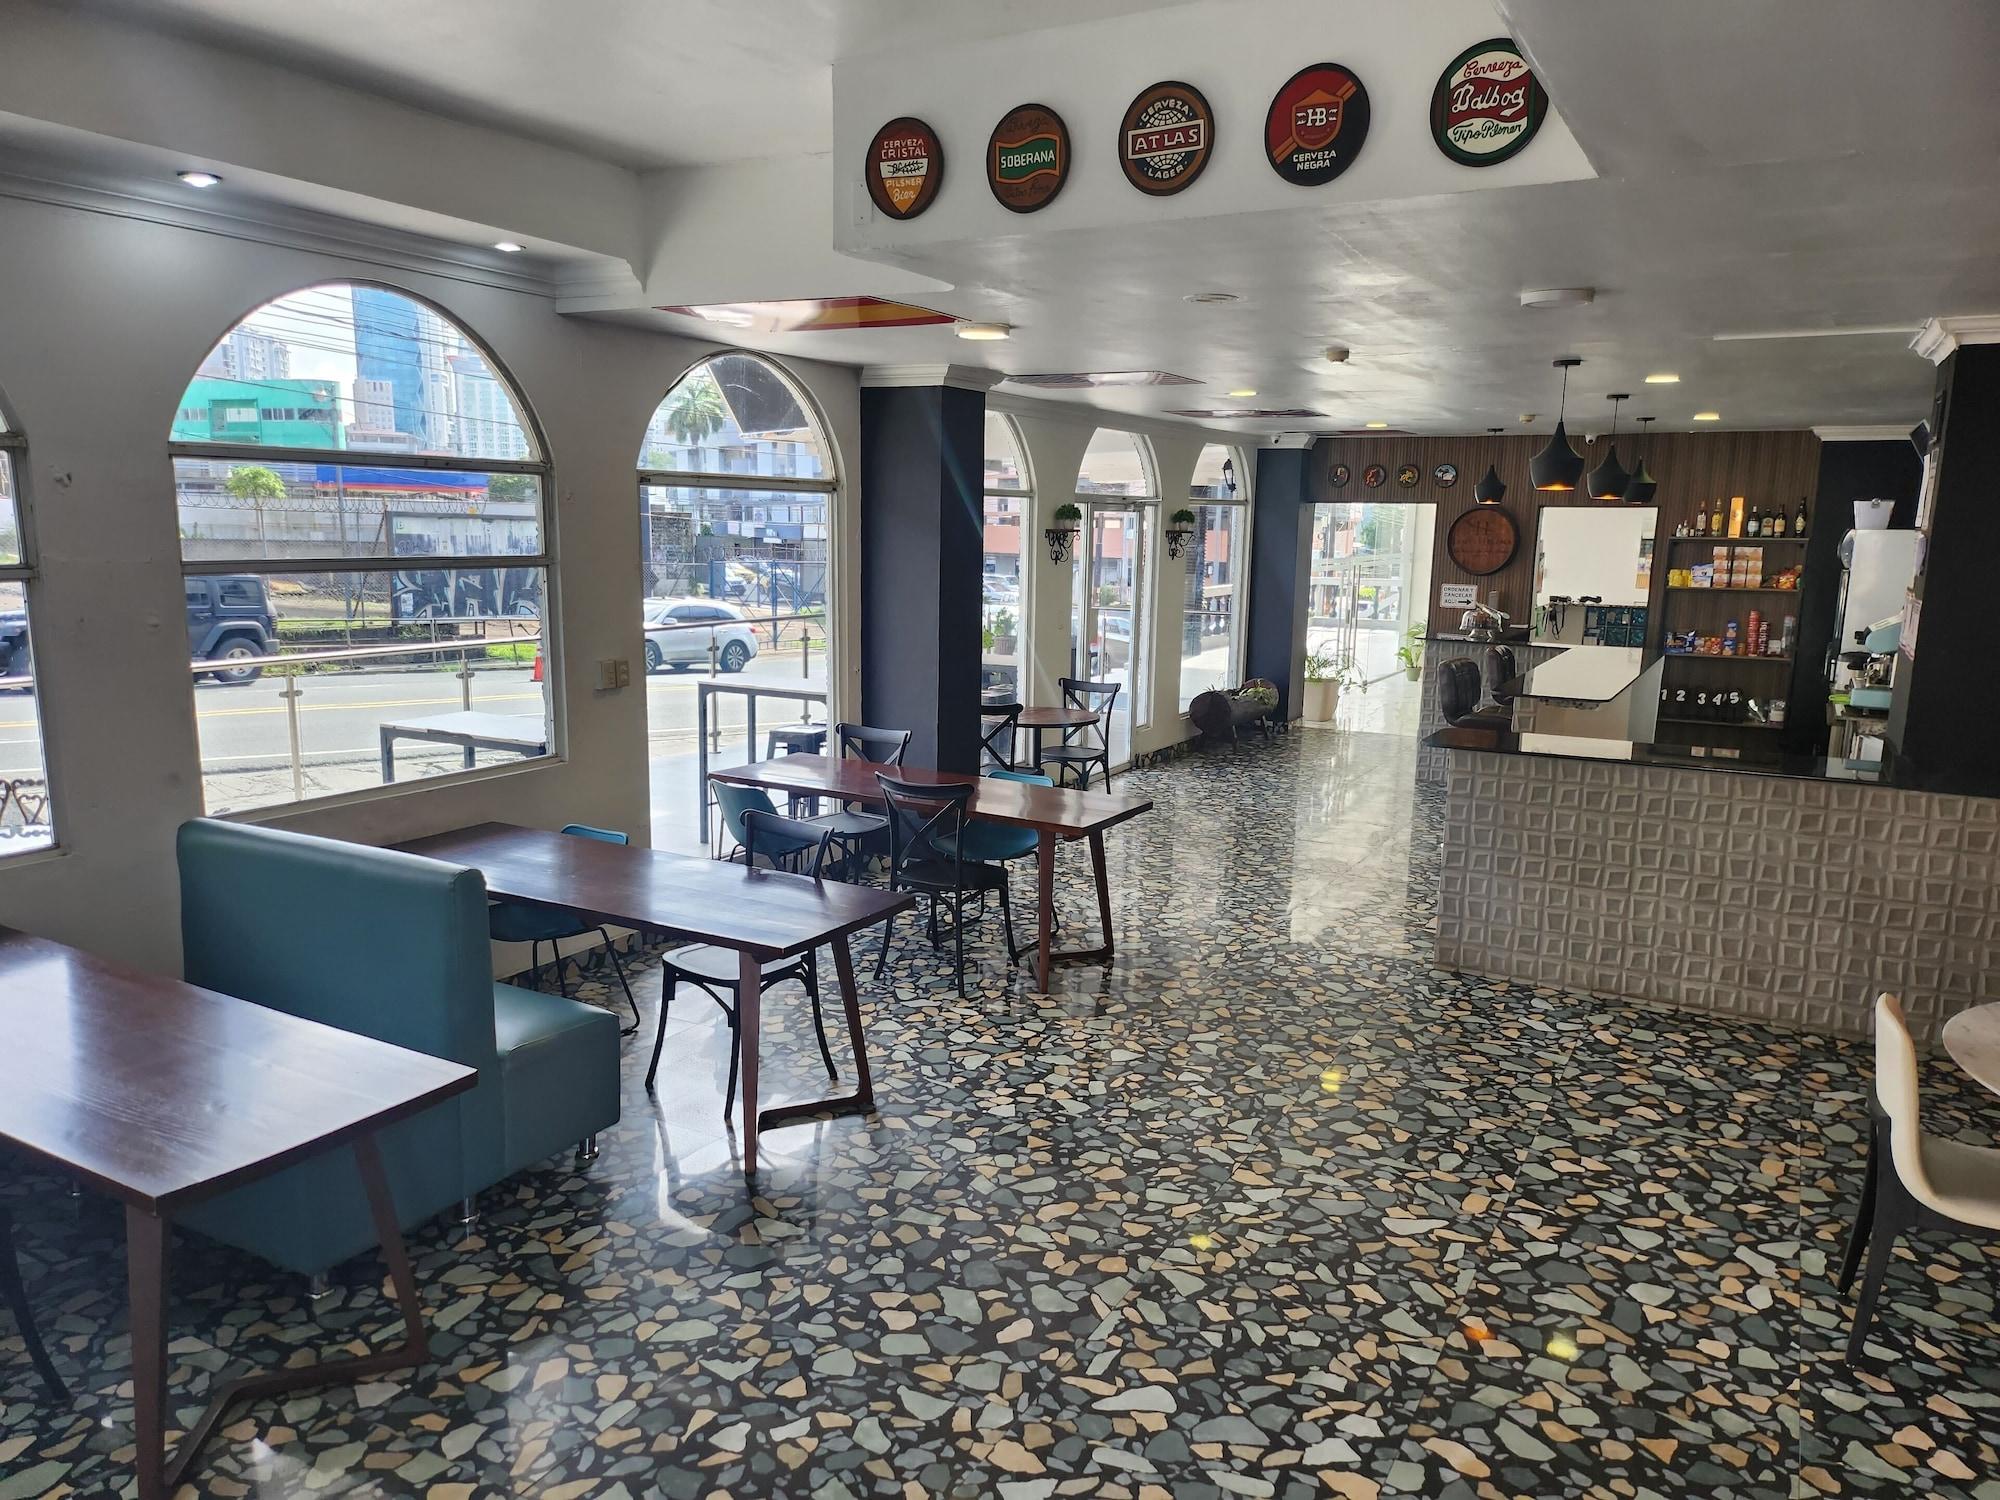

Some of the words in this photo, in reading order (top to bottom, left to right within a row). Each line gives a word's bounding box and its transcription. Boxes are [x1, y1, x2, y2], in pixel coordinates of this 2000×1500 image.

[1463, 60, 1523, 78] Cerveza
[1141, 99, 1189, 122] CERVEZA
[1135, 128, 1199, 151] ATLAS
[1453, 122, 1482, 144] Tipo
[884, 138, 924, 149] CERVEZA
[881, 147, 927, 159] CRISTAL
[1000, 150, 1055, 168] SOBERANA
[1293, 150, 1336, 162] CERVEZA
[1148, 165, 1184, 179] LAGER
[1297, 159, 1330, 171] NEGRA
[886, 177, 922, 187] PILSNER
[1661, 689, 1668, 700] 1
[1676, 690, 1686, 701] 2
[1697, 692, 1706, 704] 3
[1712, 693, 1722, 705] 4
[1729, 692, 1739, 704] 5
